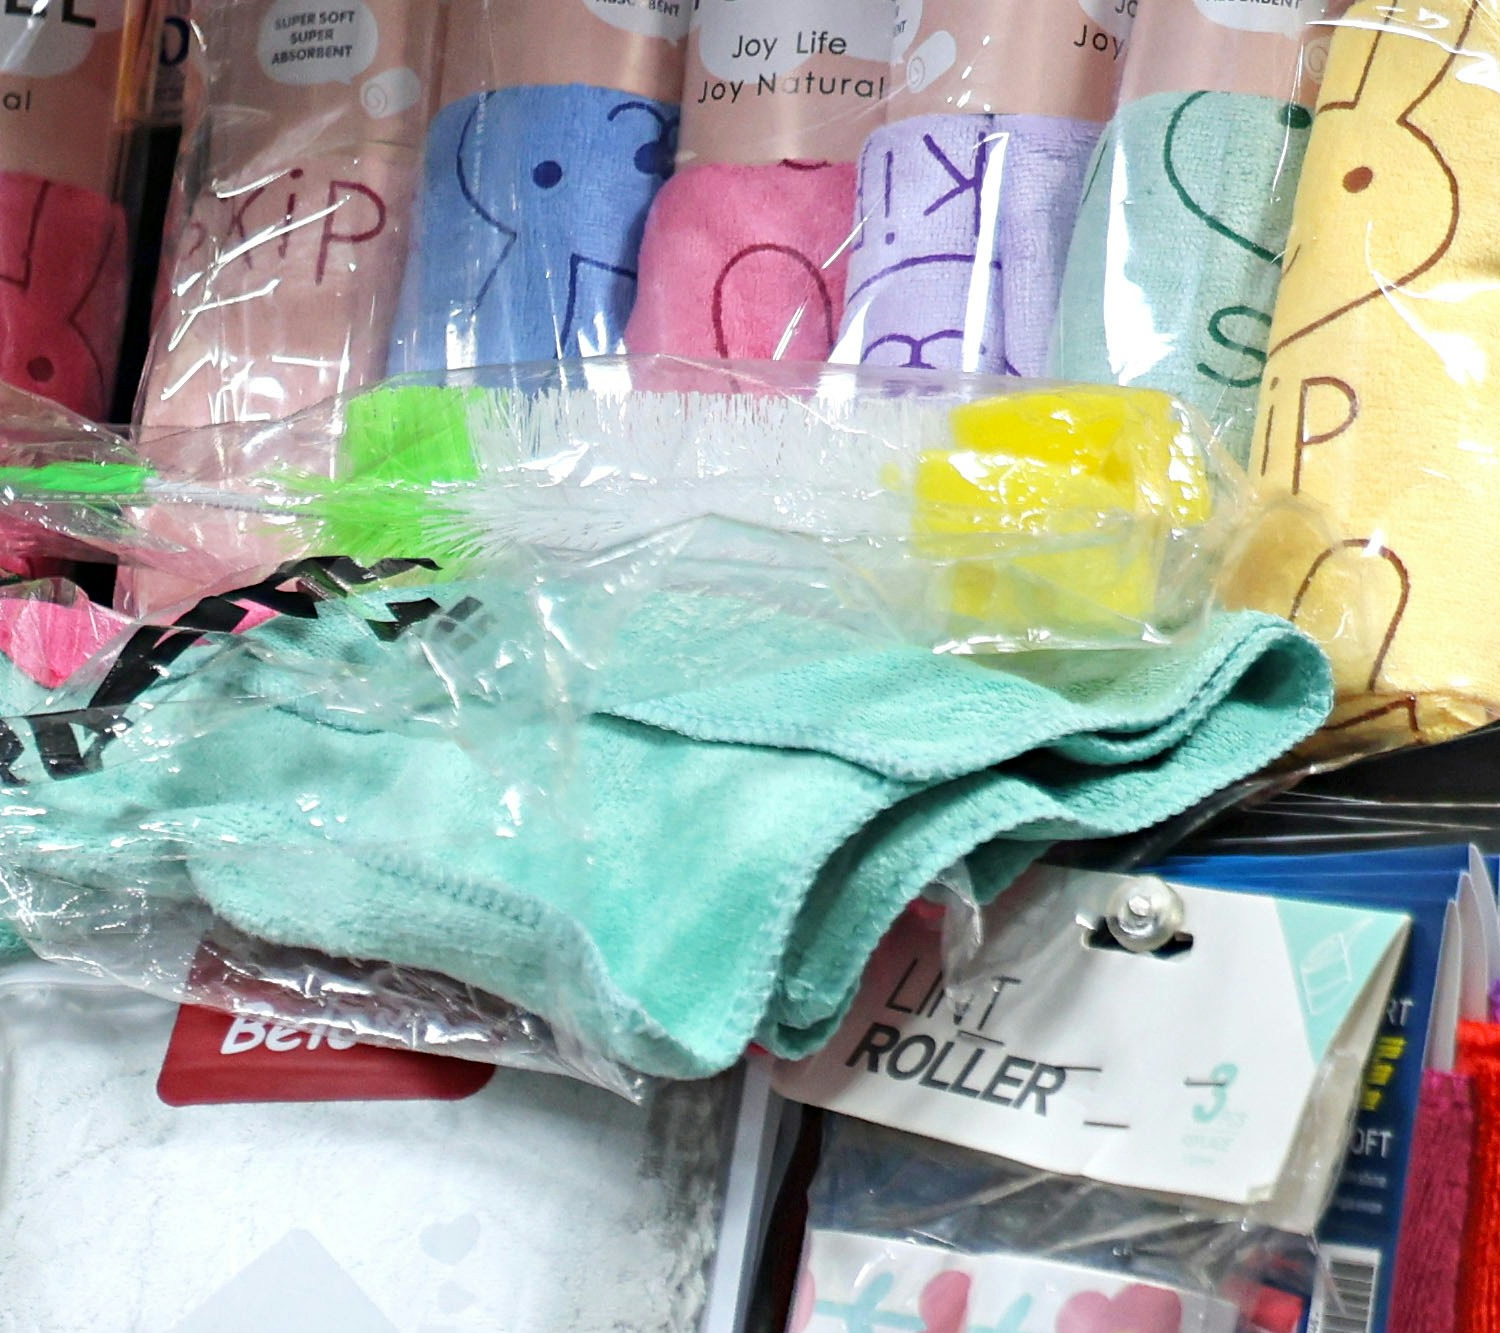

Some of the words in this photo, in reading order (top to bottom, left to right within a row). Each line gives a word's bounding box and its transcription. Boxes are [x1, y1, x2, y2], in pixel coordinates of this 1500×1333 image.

[319, 11, 355, 25] SOFT
[732, 35, 777, 60] Joy
[797, 32, 847, 55] Life
[1074, 25, 1125, 60] Joy
[698, 77, 744, 103] Joy
[757, 73, 886, 99] Natural
[885, 958, 1021, 1038] LINT
[845, 1023, 1067, 1116] ROLLER
